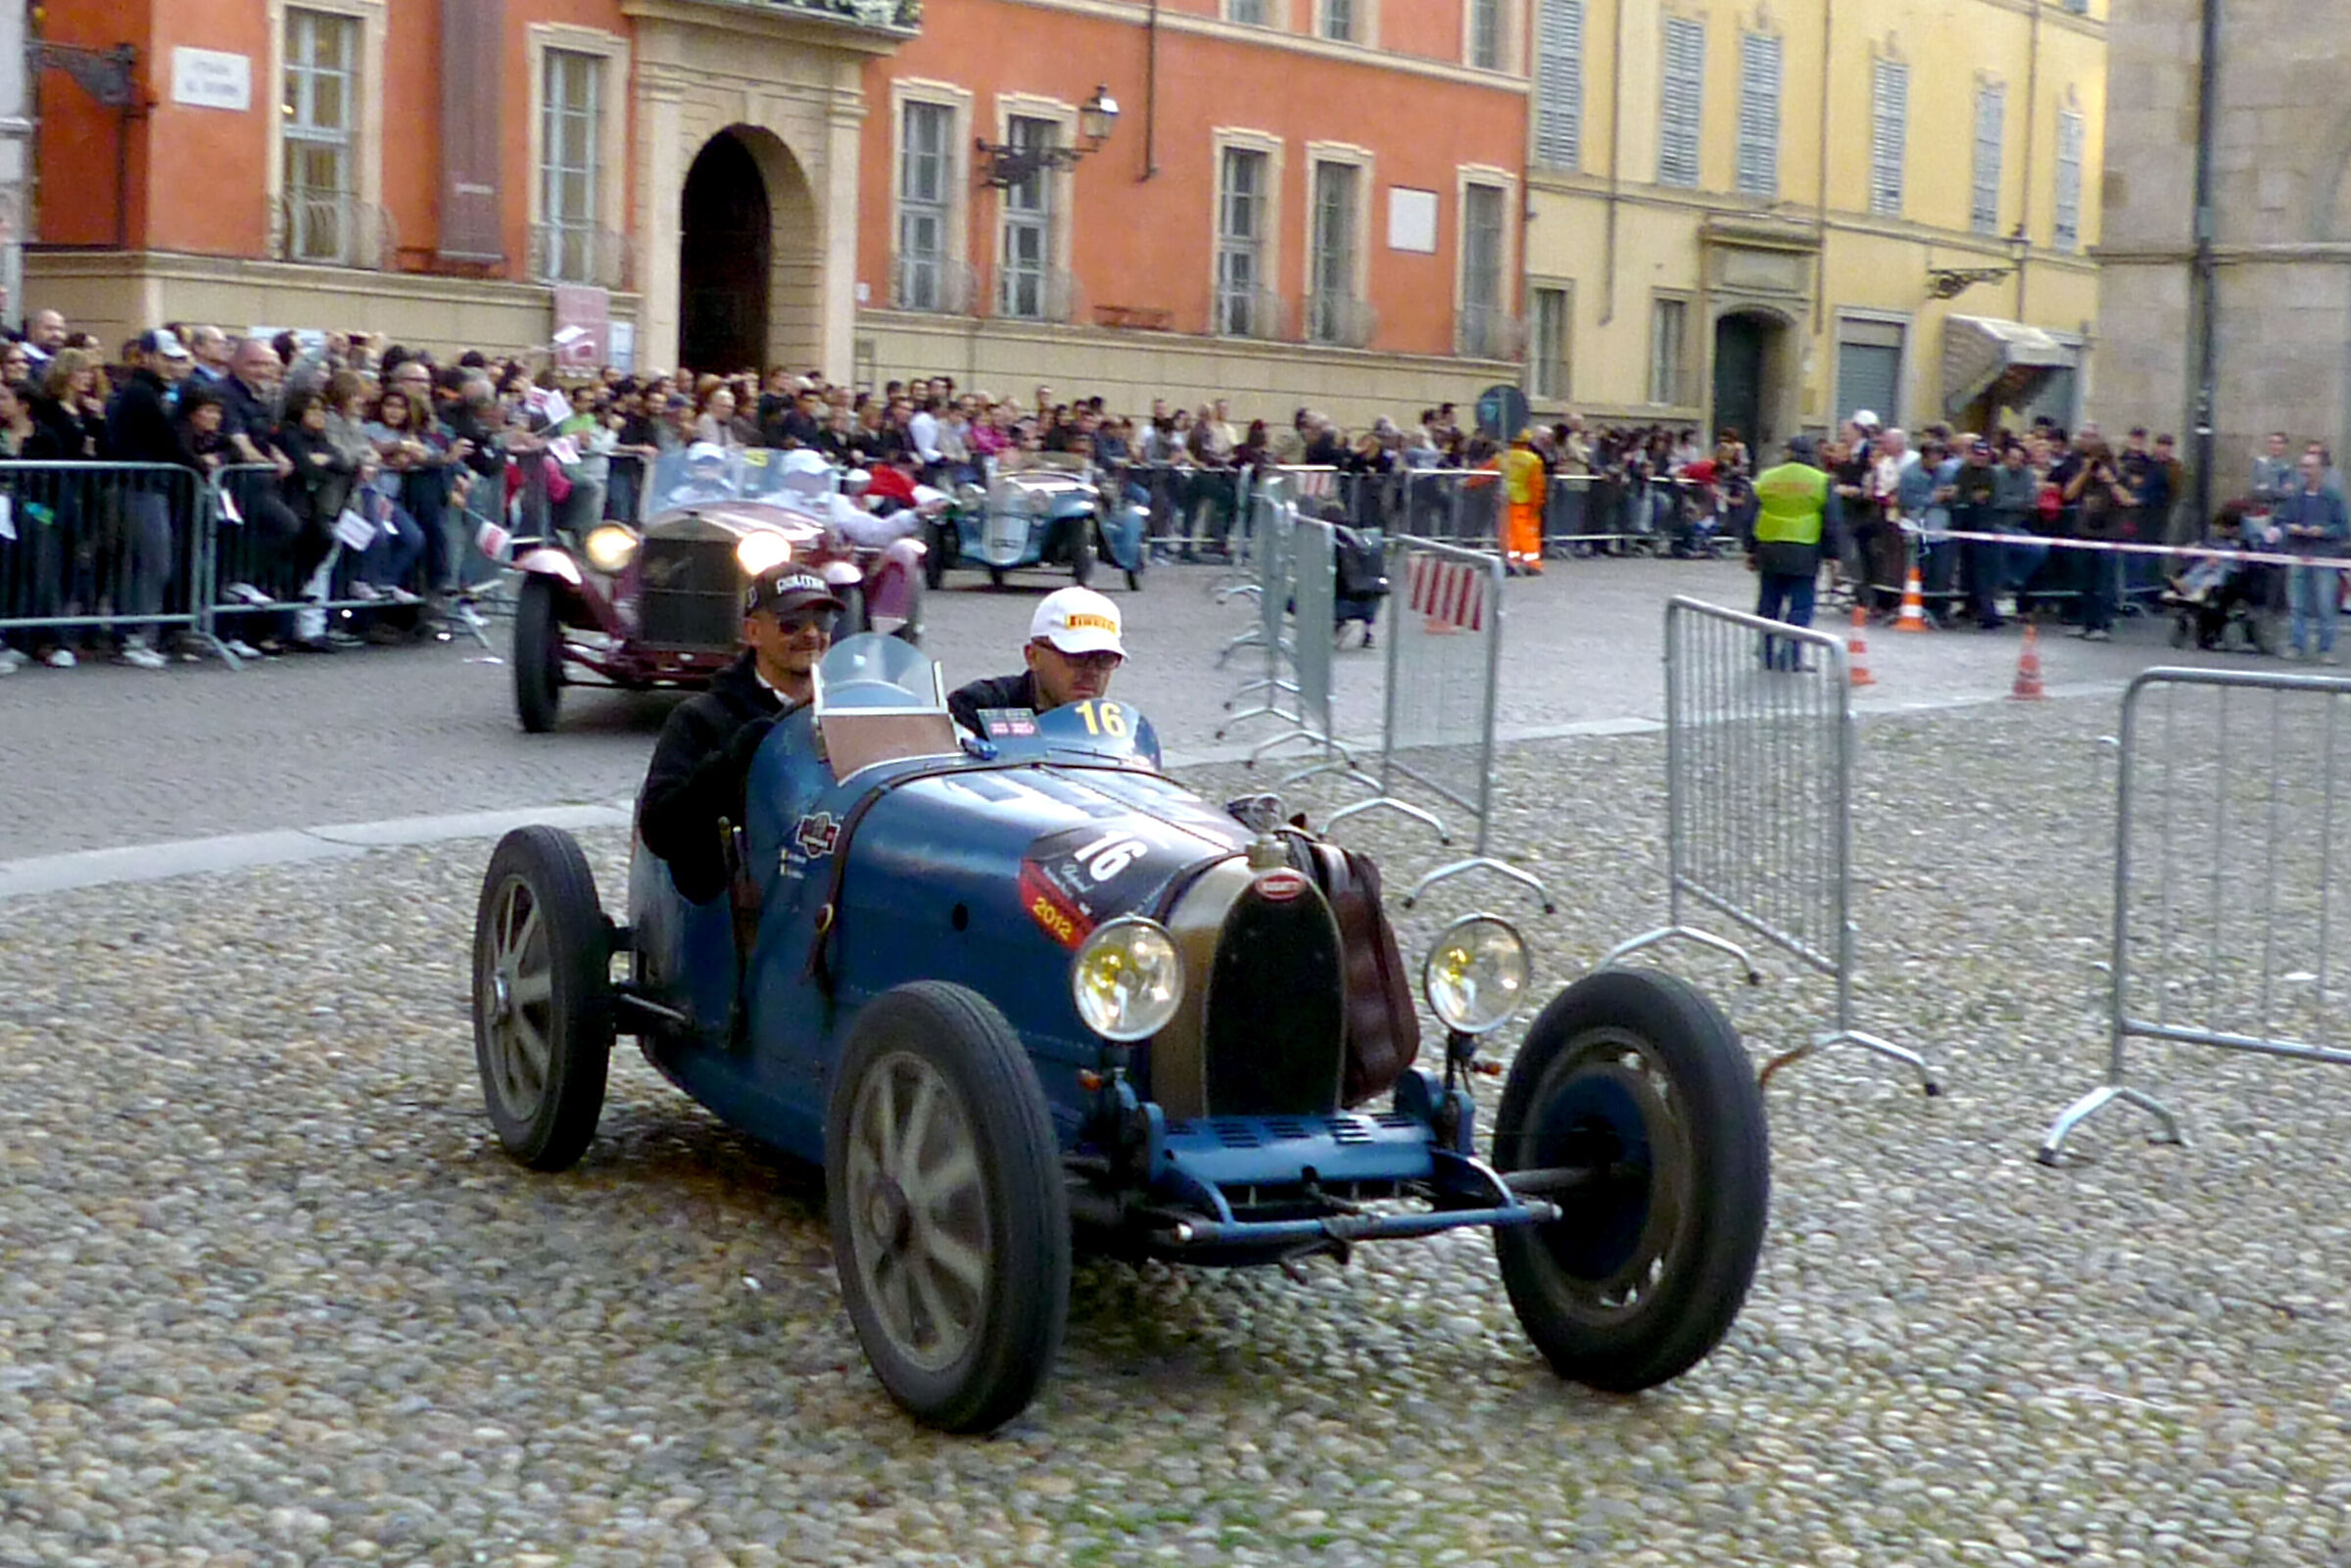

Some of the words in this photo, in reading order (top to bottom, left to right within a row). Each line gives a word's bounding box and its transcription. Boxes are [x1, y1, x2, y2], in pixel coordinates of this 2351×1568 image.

[1075, 700, 1127, 737] 16
[1074, 831, 1148, 881] 16
[1032, 896, 1073, 941] 2012
